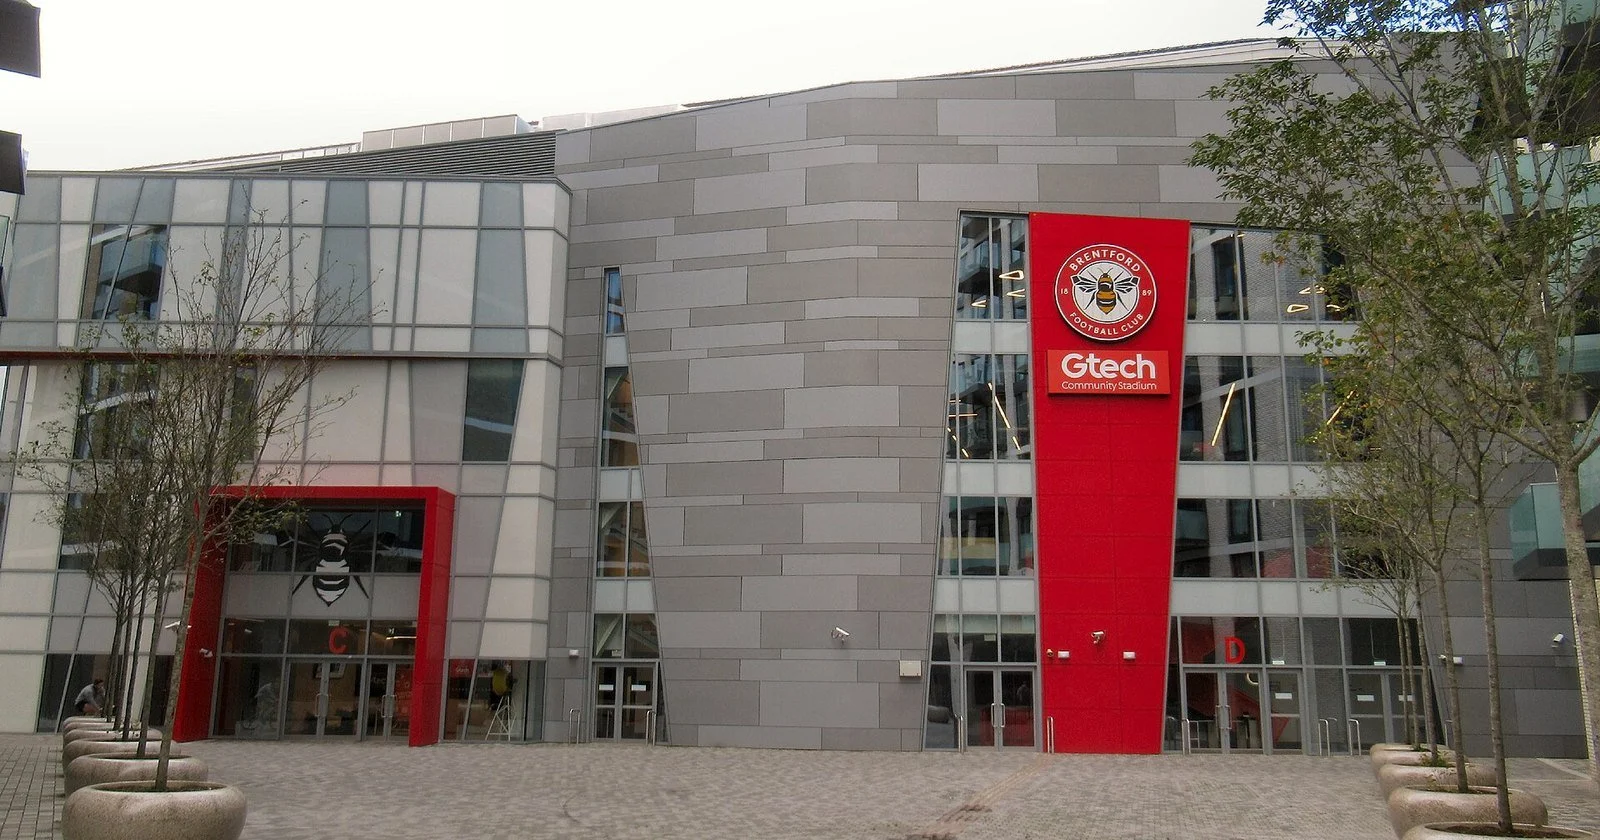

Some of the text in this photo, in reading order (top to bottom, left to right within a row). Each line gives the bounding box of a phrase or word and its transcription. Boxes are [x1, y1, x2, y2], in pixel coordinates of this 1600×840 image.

[1069, 249, 1141, 273] BRENTFORD
[1069, 312, 1144, 336] FOOTBALL CLUB
[1061, 353, 1156, 379] Gtech
[1061, 381, 1157, 392] Community Stadium
[328, 627, 348, 654] C
[1225, 636, 1246, 664] D
